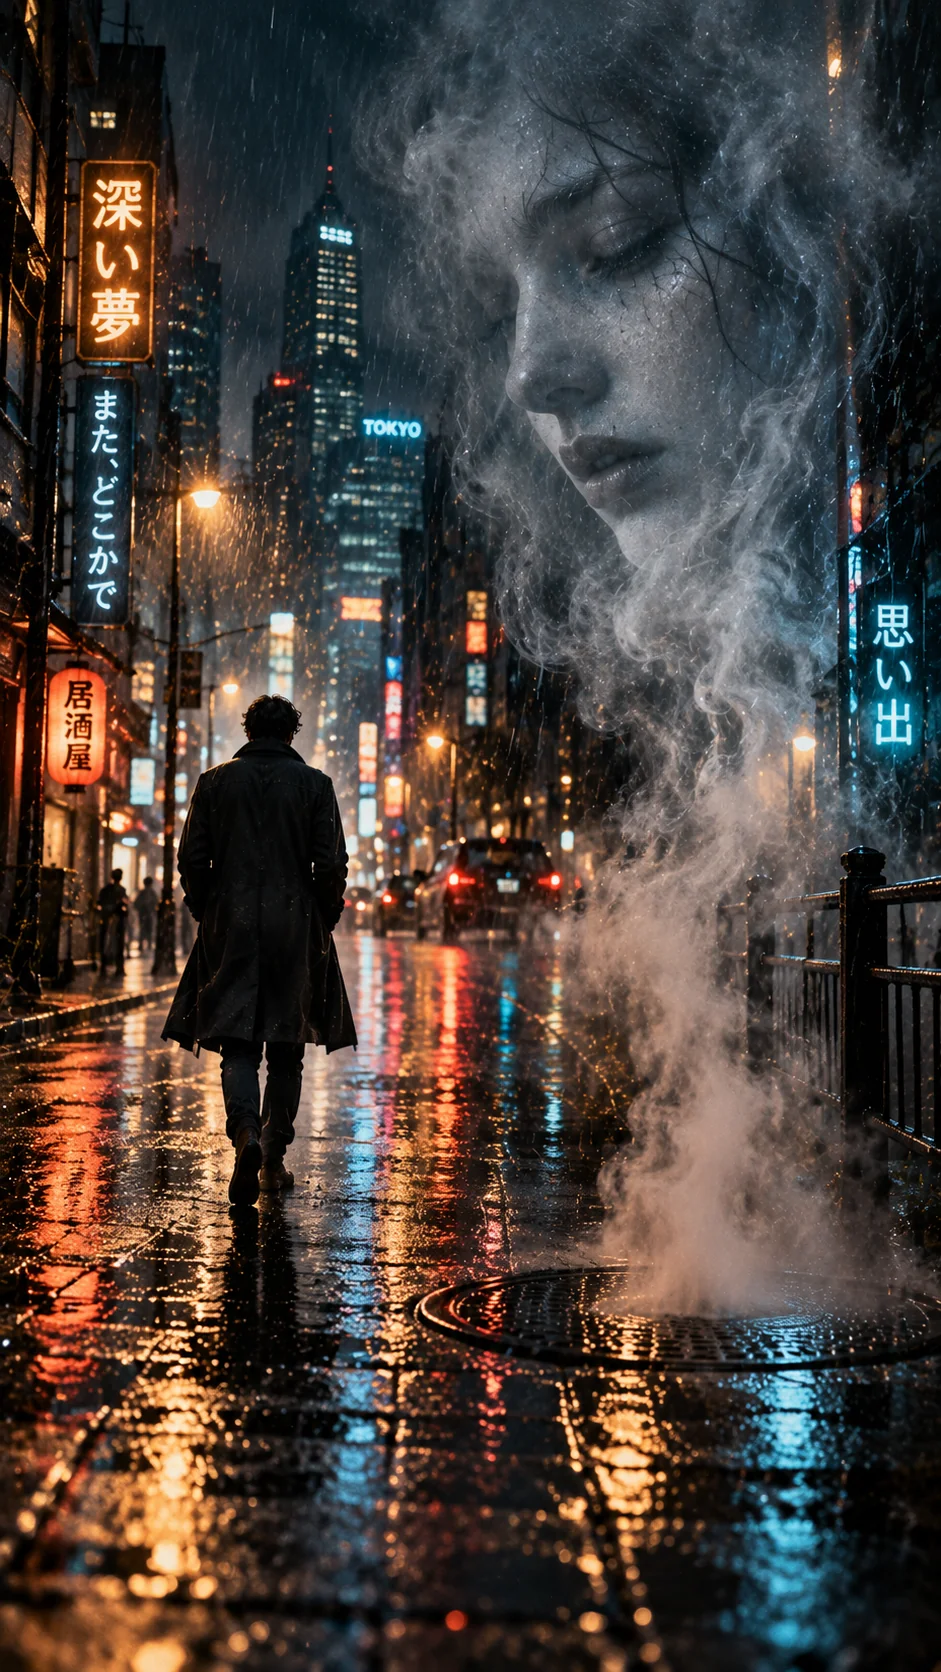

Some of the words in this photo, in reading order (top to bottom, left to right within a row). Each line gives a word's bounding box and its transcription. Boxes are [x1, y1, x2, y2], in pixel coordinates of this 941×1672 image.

[90, 180, 142, 342] 深い夢
[363, 418, 422, 438] TOKYO
[87, 390, 118, 610] また、どこかで
[63, 680, 93, 771] 居酒屋
[873, 604, 914, 746] 思い出
